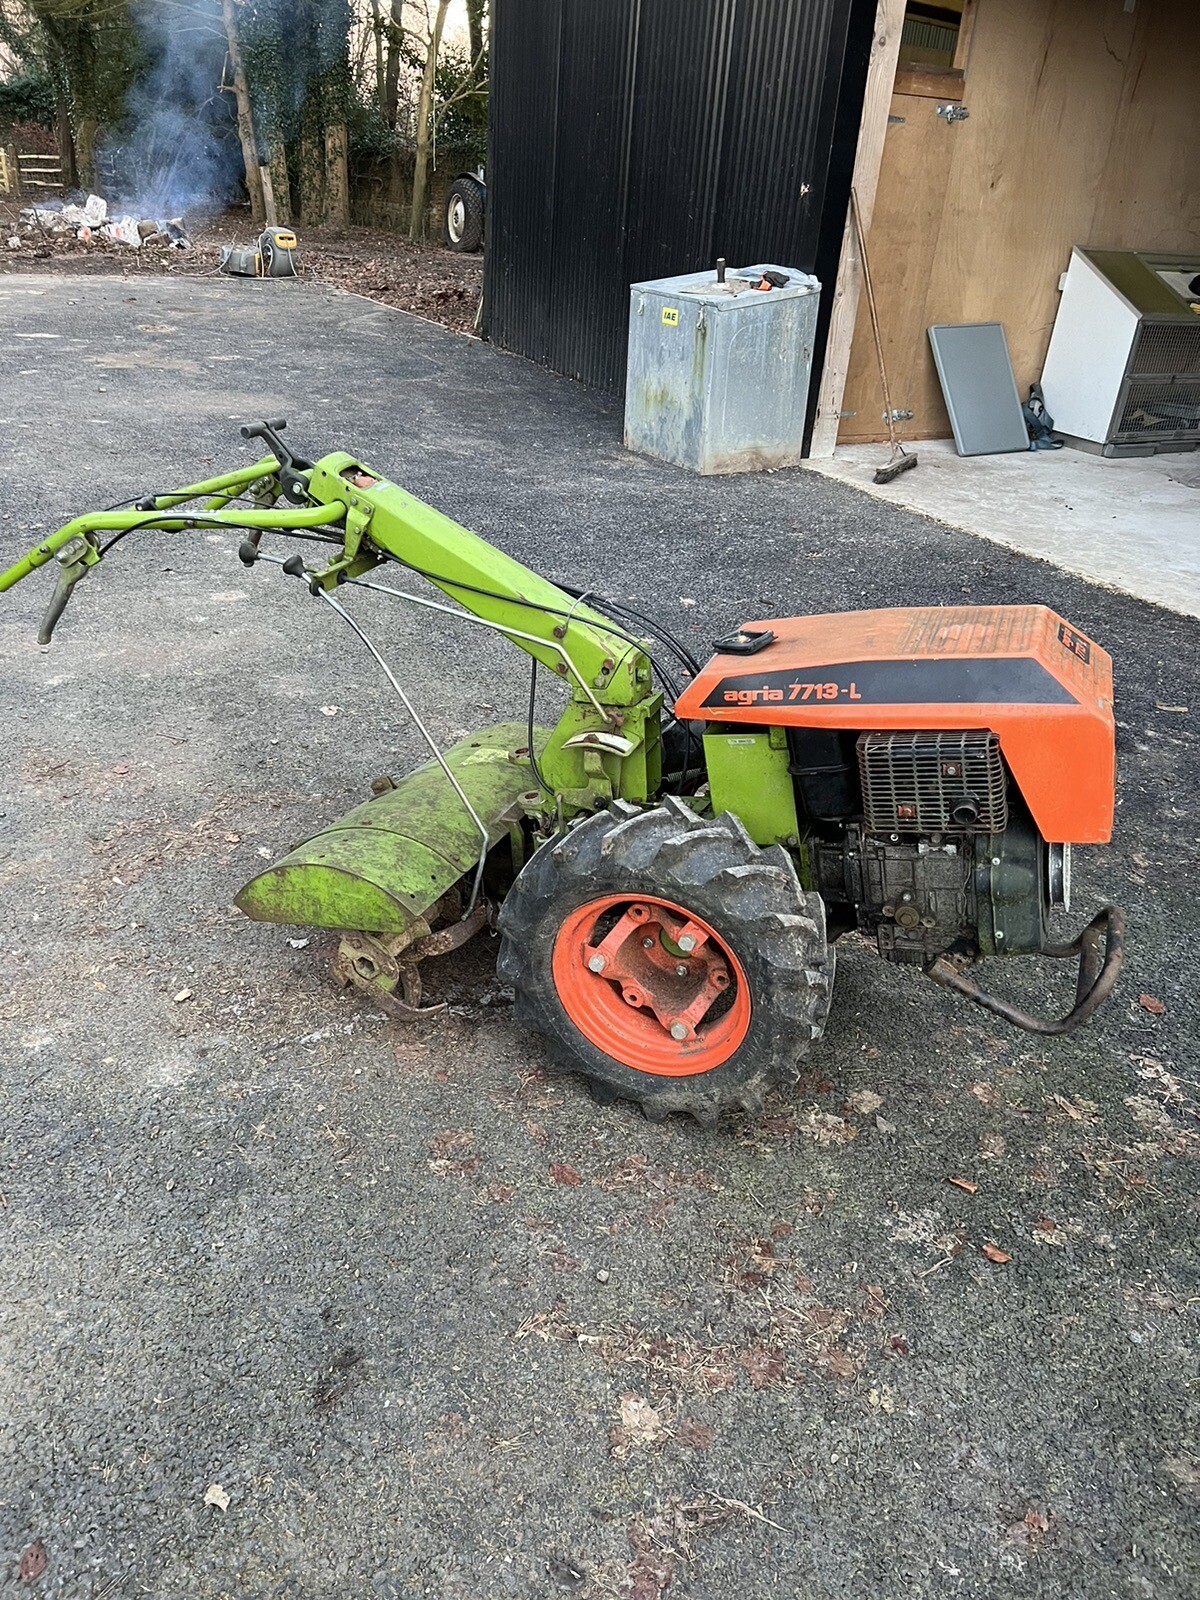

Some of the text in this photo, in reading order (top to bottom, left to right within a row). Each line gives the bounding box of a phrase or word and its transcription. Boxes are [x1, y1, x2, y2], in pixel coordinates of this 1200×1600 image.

[663, 311, 677, 321] IAE
[723, 682, 862, 705] agria 7713-L
